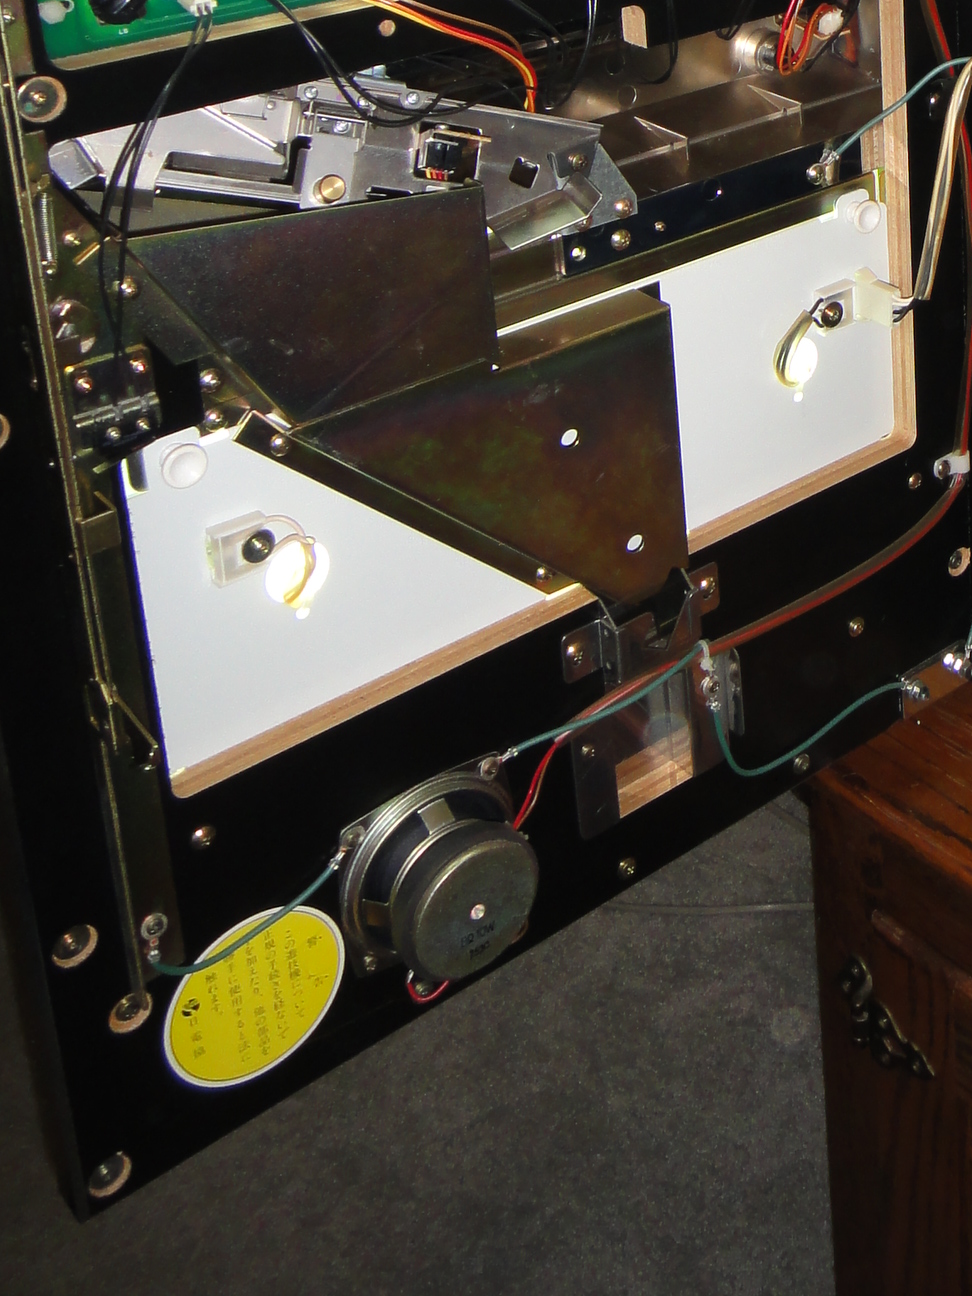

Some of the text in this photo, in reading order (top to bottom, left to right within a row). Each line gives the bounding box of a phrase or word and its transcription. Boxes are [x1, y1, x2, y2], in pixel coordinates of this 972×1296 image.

[245, 942, 271, 1057] を加えたり、他の部品を
